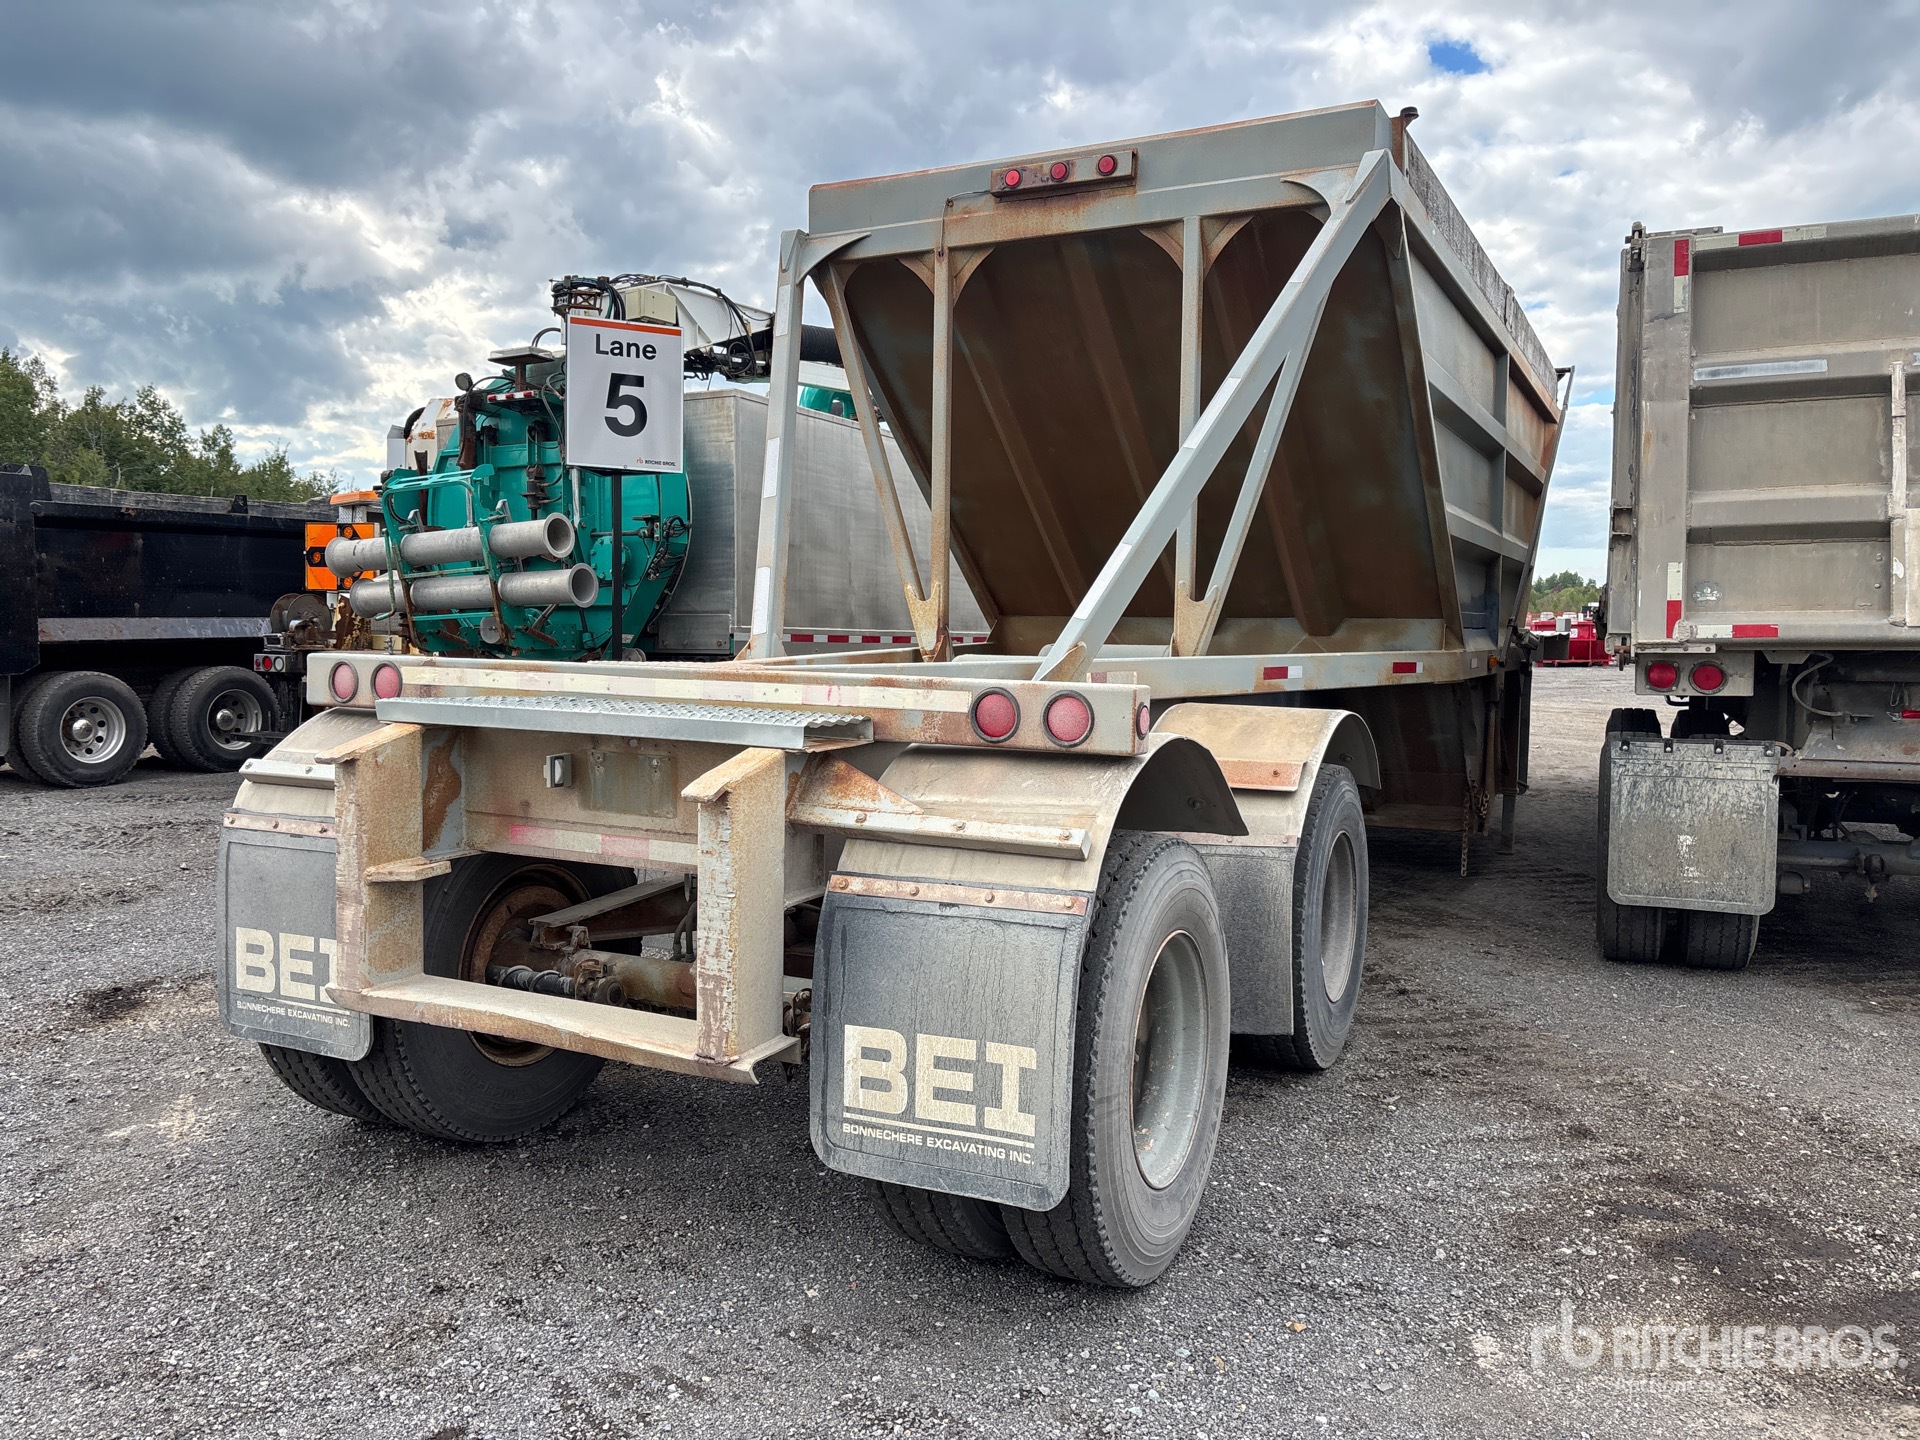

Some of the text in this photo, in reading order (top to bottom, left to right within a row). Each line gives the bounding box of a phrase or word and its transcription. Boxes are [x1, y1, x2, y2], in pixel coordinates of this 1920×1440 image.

[595, 333, 657, 361] Lane
[604, 372, 648, 437] 5
[236, 1000, 351, 1028] BONNECHERE EXCAVATING INC.
[843, 1024, 1037, 1137] BEI
[842, 1122, 1035, 1166] BONNECHERE EXCAVATING INC.
